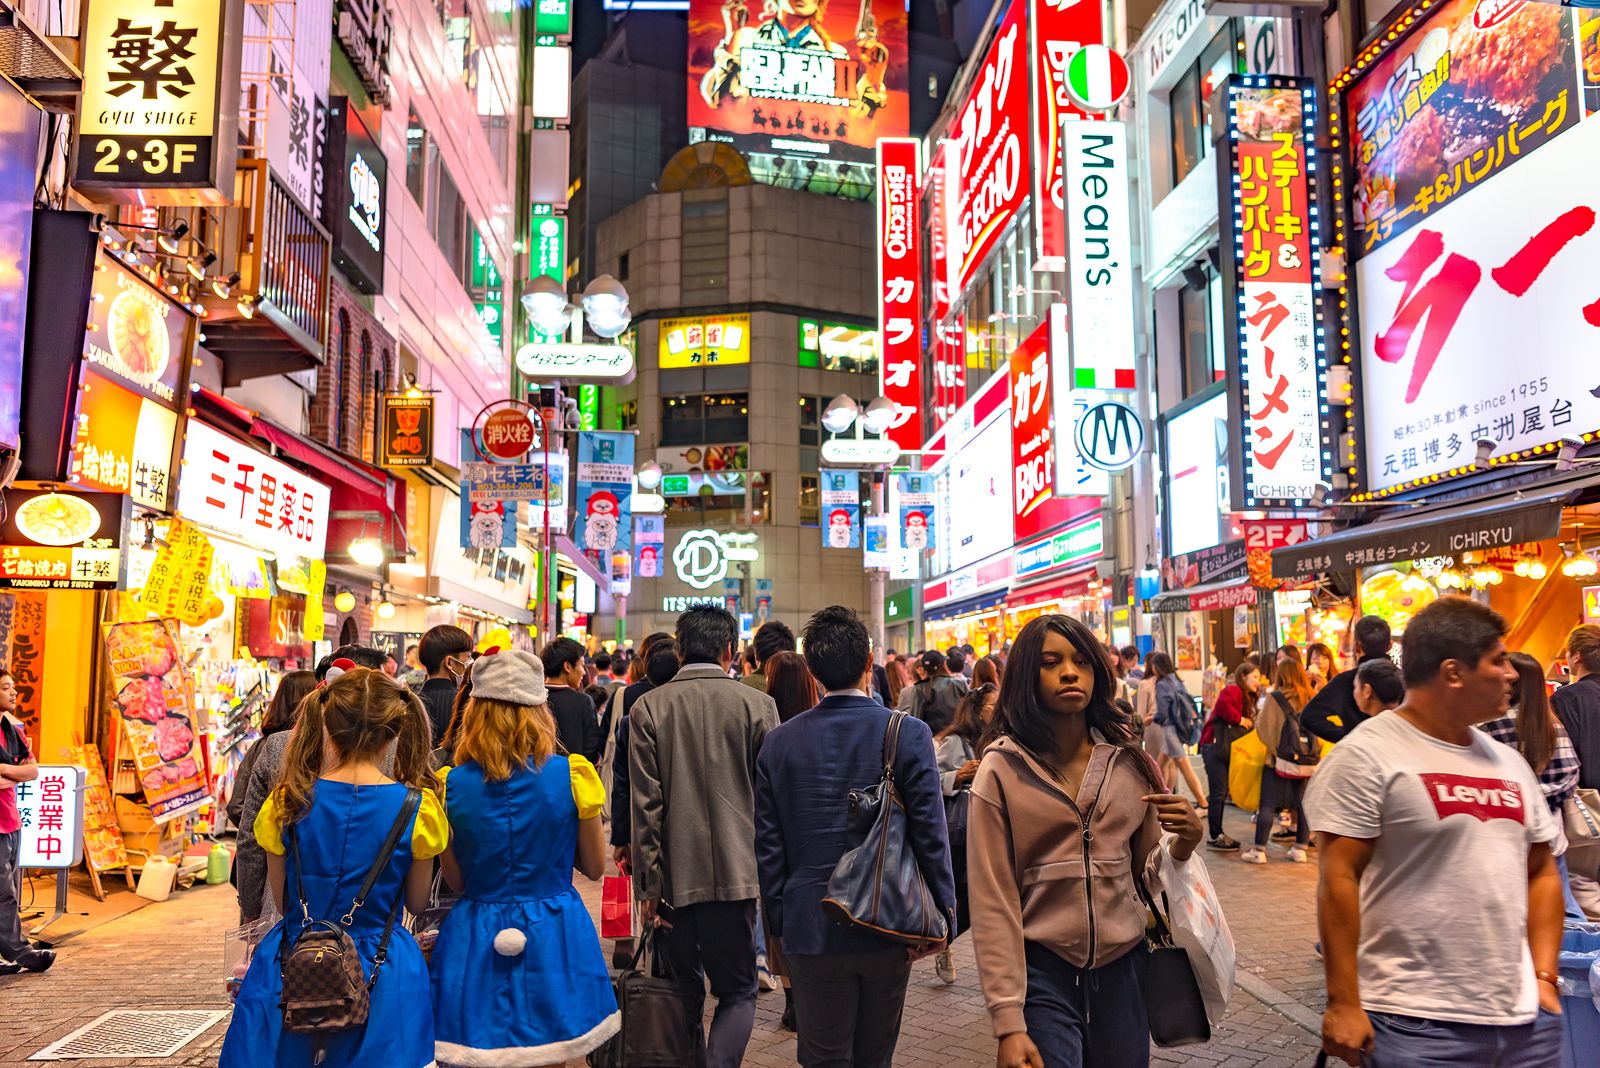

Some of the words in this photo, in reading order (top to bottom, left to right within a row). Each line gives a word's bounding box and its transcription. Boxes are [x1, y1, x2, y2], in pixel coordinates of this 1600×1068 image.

[105, 0, 198, 99] 繁
[98, 109, 135, 126] GYU
[143, 109, 198, 126] SHIGE
[1357, 54, 1422, 141] ライス
[287, 171, 307, 204] HIGE
[884, 164, 906, 212] BIG
[1081, 133, 1119, 287] Mean's
[1271, 132, 1302, 241] ステーキ
[886, 212, 907, 260] ECHO
[1240, 155, 1271, 277] ハンバーグ
[1374, 205, 1600, 405] ラー
[884, 276, 917, 430] カラオケ
[1246, 290, 1295, 471] ラーメン
[1473, 393, 1507, 413] since
[1510, 376, 1549, 402] 1955
[487, 423, 531, 445] 消火栓
[1383, 432, 1463, 477] 元祖博多
[205, 449, 314, 542] 三千里薬品
[1247, 525, 1286, 548] 2F
[1450, 526, 1513, 551] ICHIRYU
[11, 579, 50, 588] YAKINIKU
[76, 559, 111, 577] 牛繁
[36, 774, 66, 861] 営業中
